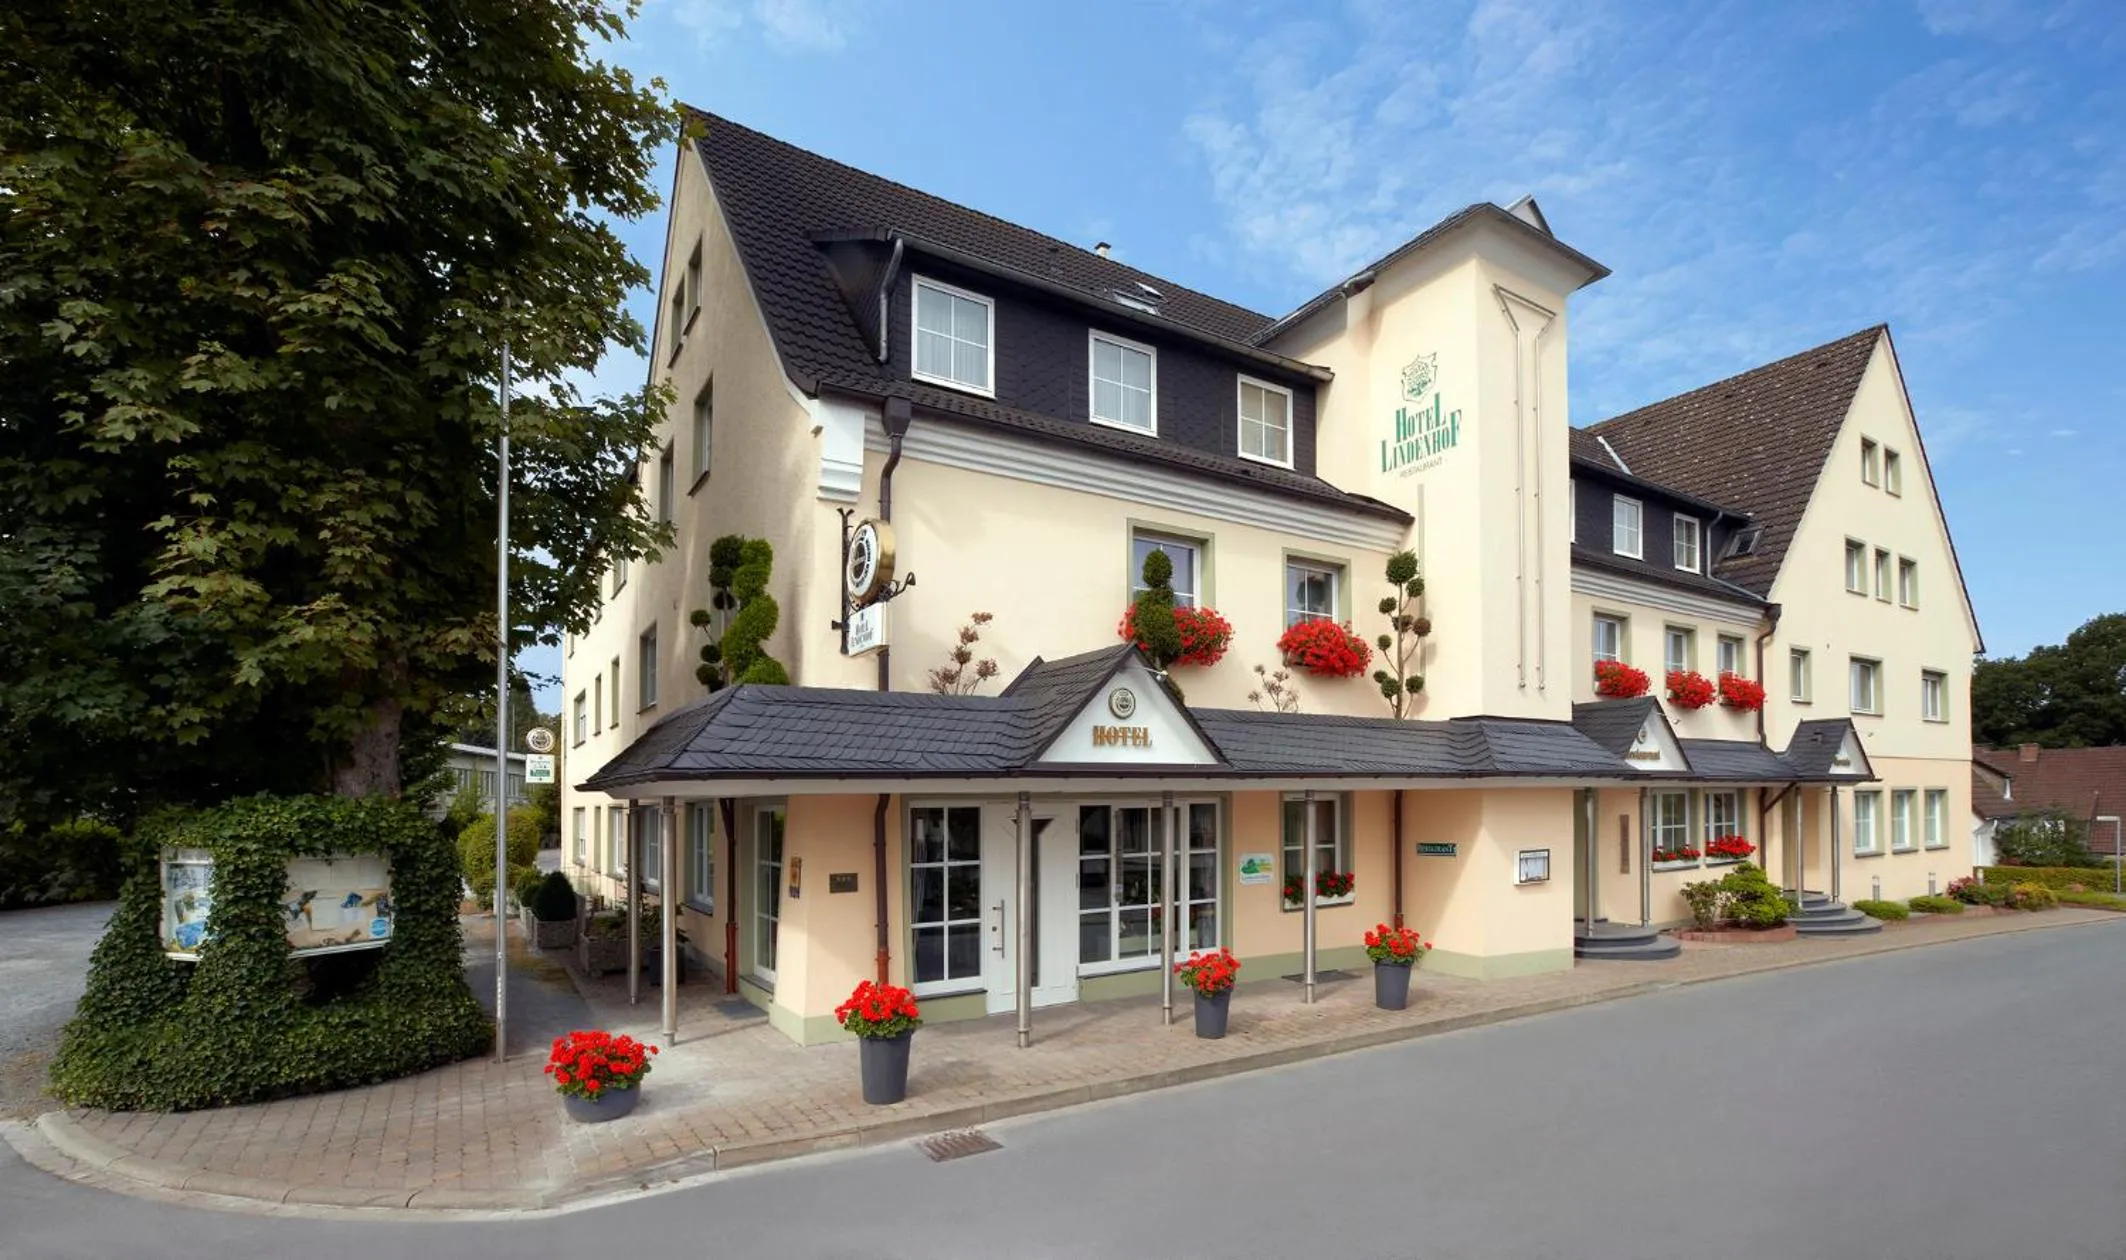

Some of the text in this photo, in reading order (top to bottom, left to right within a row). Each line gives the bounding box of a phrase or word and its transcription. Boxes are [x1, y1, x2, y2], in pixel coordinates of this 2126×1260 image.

[1381, 409, 1462, 473] LINDENHOF
[1396, 392, 1446, 444] HOTEL
[1092, 725, 1153, 748] HOTEL
